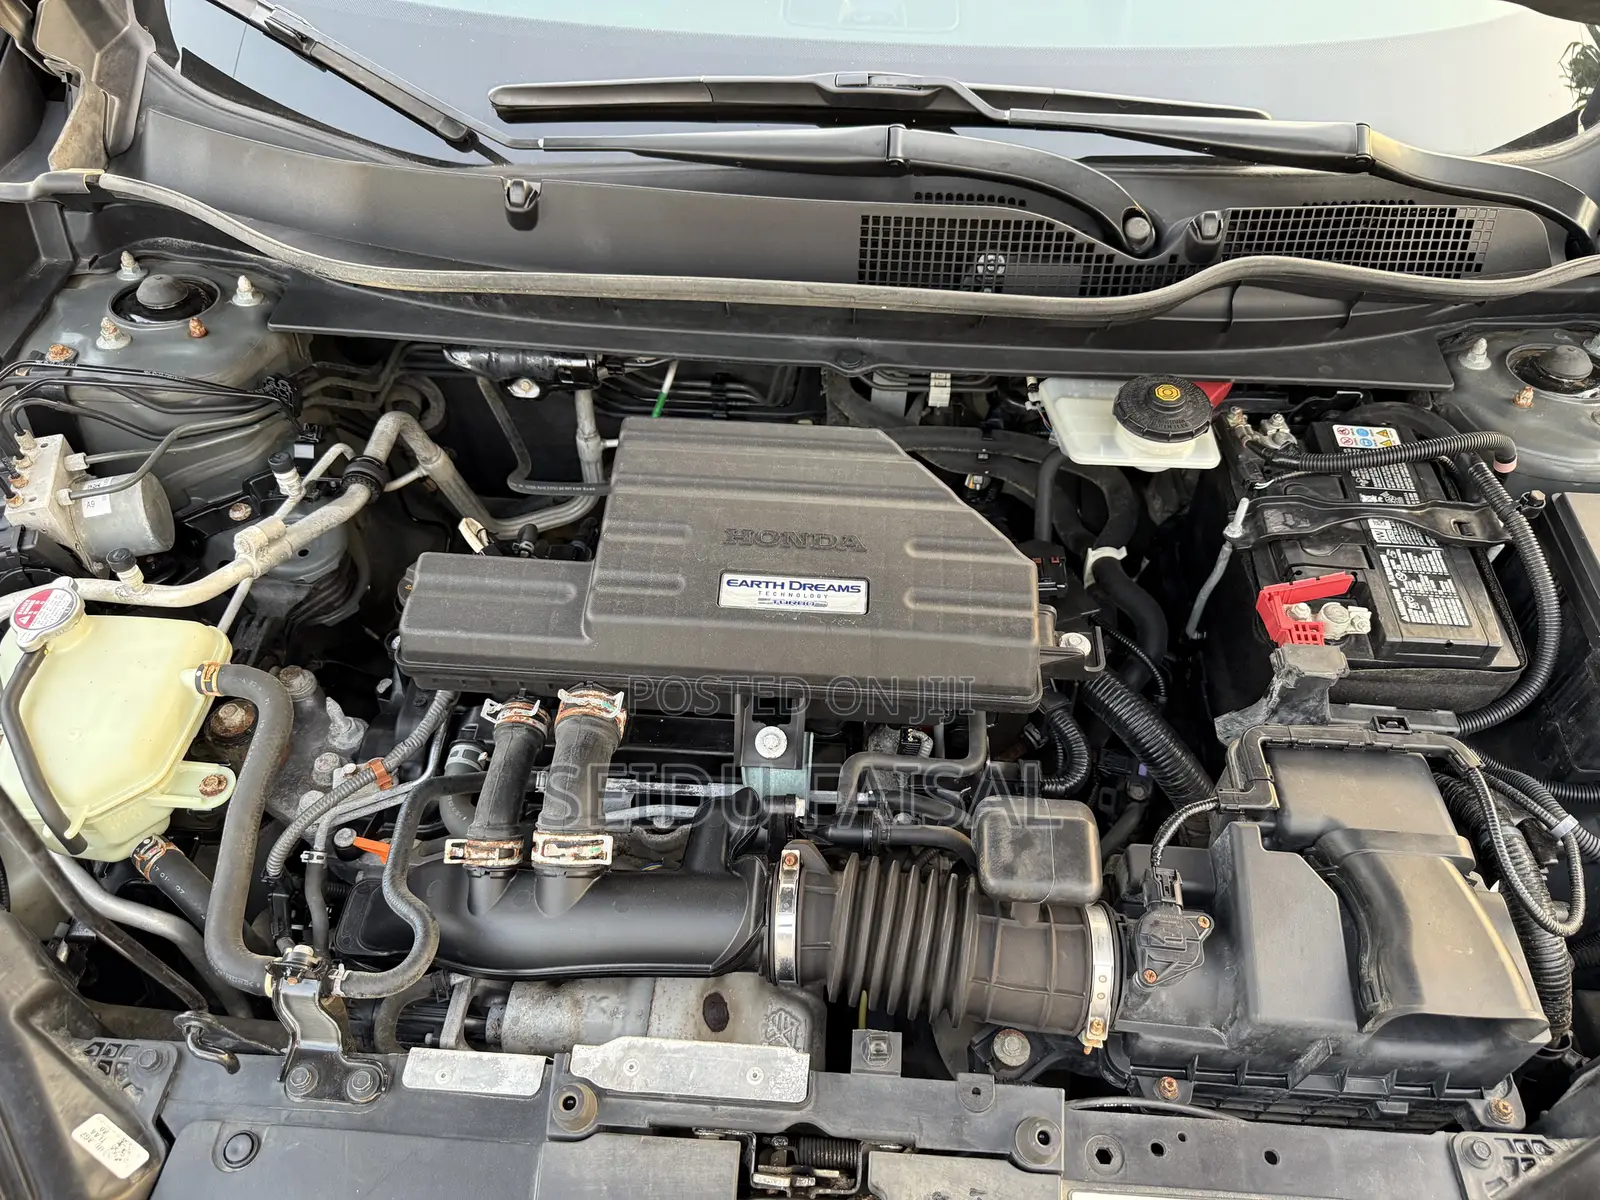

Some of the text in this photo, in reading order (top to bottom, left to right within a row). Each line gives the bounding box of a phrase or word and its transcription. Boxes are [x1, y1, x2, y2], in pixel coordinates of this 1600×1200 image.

[722, 528, 868, 553] HONDA
[726, 578, 862, 594] EARTH DREAMS
[758, 590, 829, 599] TECHNOLOGY
